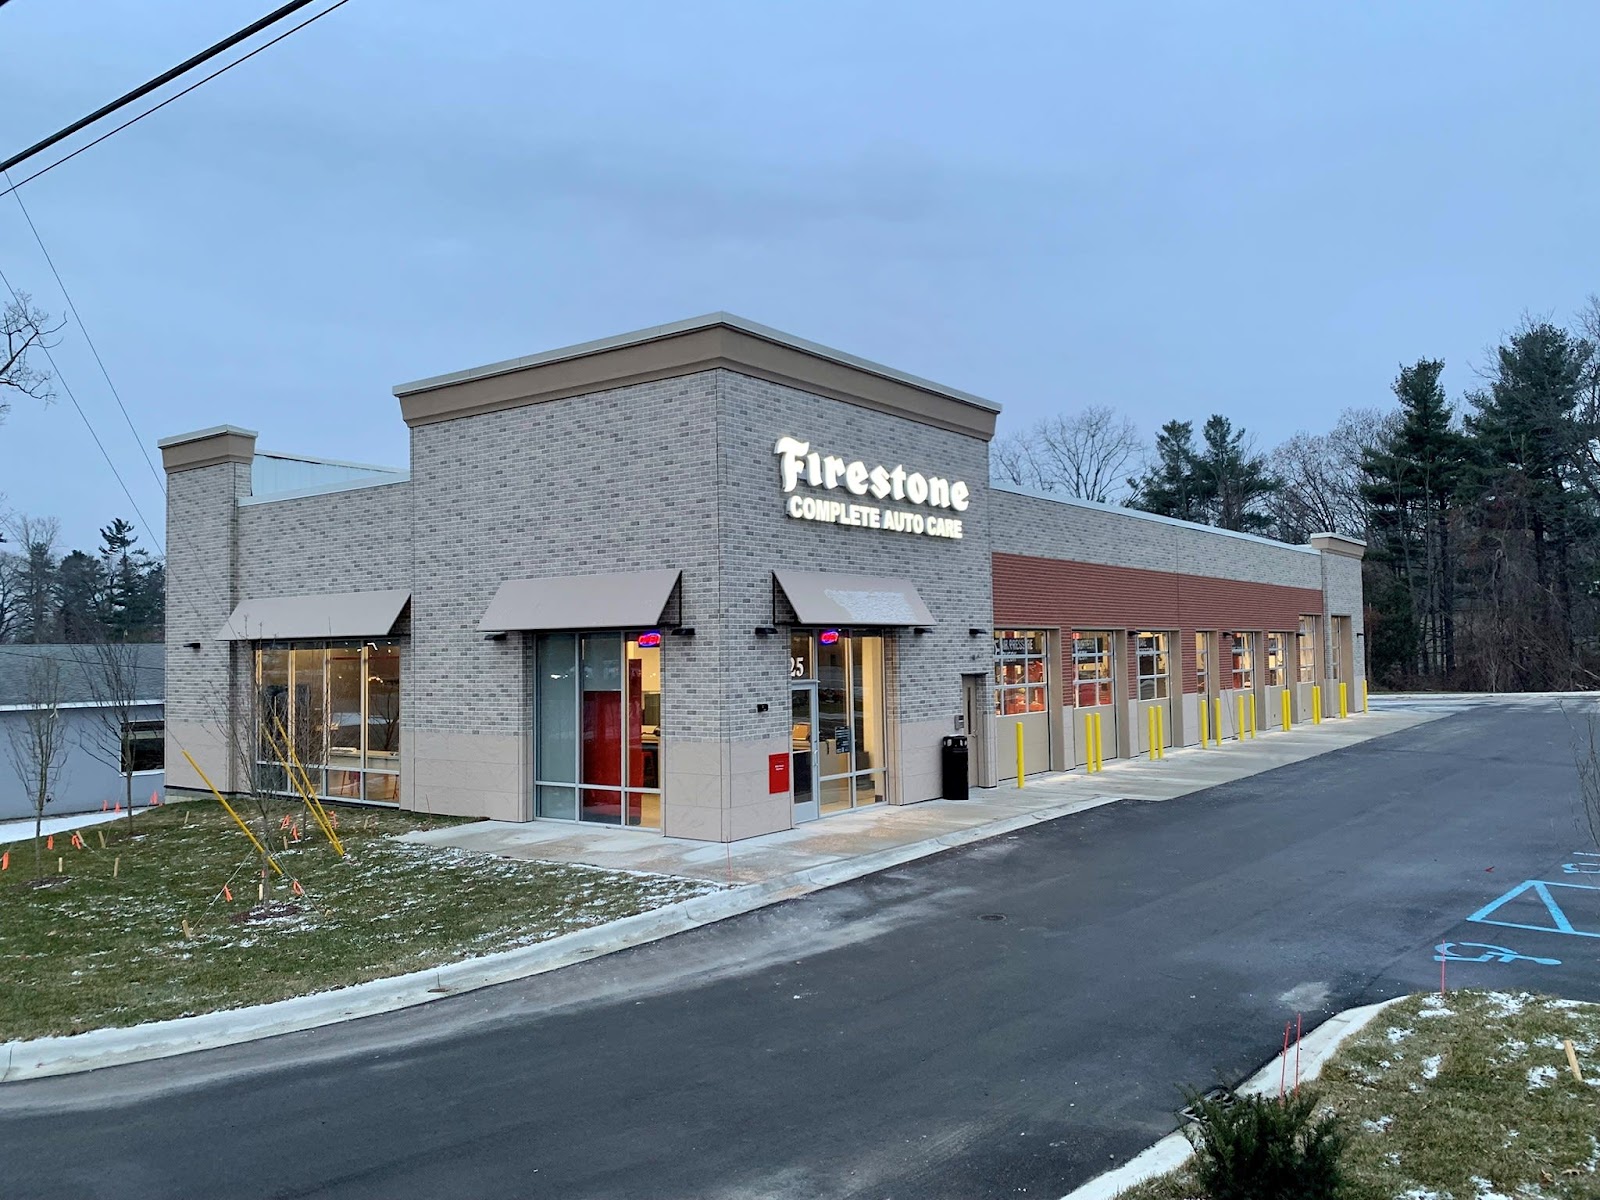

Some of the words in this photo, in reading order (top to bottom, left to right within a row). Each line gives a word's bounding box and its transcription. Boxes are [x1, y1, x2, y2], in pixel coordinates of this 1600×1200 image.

[774, 436, 970, 511] Firestone
[787, 495, 881, 529] COMPLETE
[881, 509, 924, 534] AUTO
[926, 516, 963, 539] CARE
